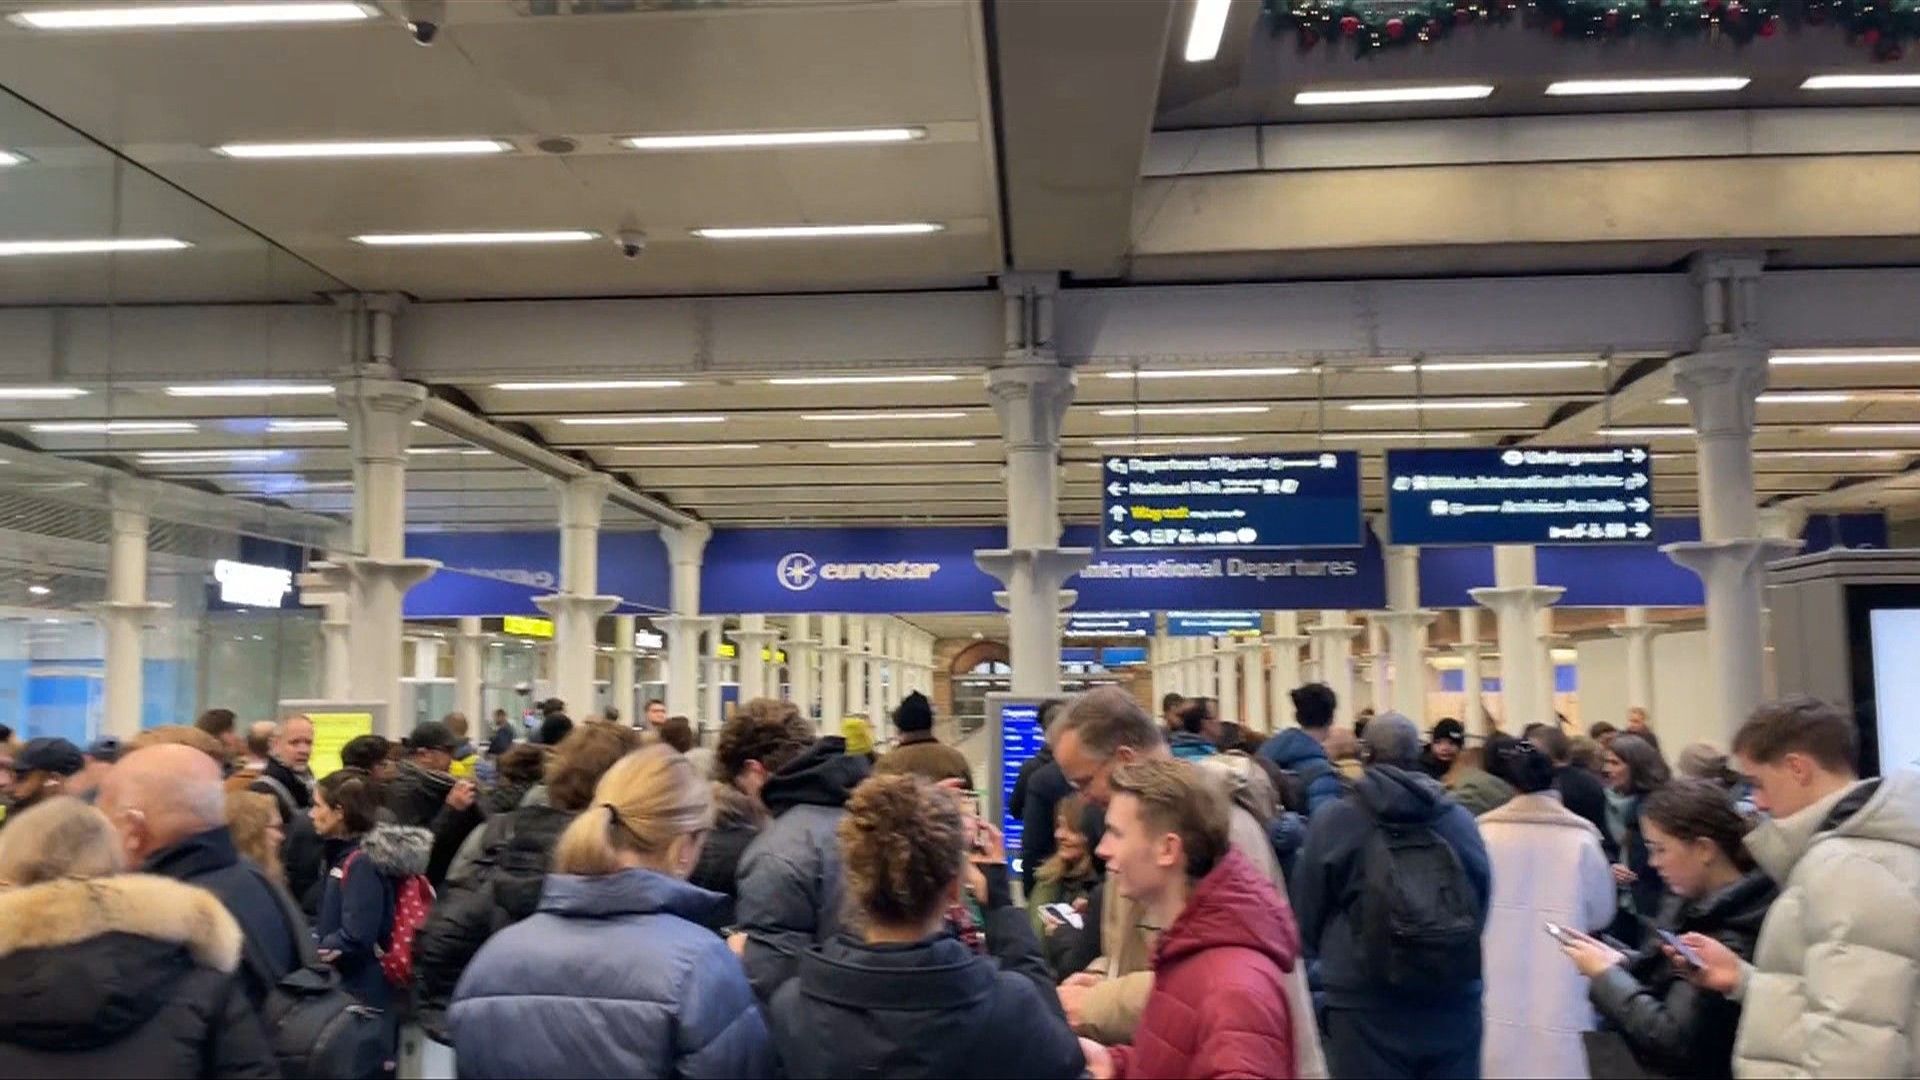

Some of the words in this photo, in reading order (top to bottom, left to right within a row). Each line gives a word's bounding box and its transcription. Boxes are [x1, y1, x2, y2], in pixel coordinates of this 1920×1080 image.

[1129, 482, 1189, 495] National
[1130, 506, 1163, 522] Way
[819, 561, 941, 580] eurostar
[1226, 558, 1358, 581] Departures
